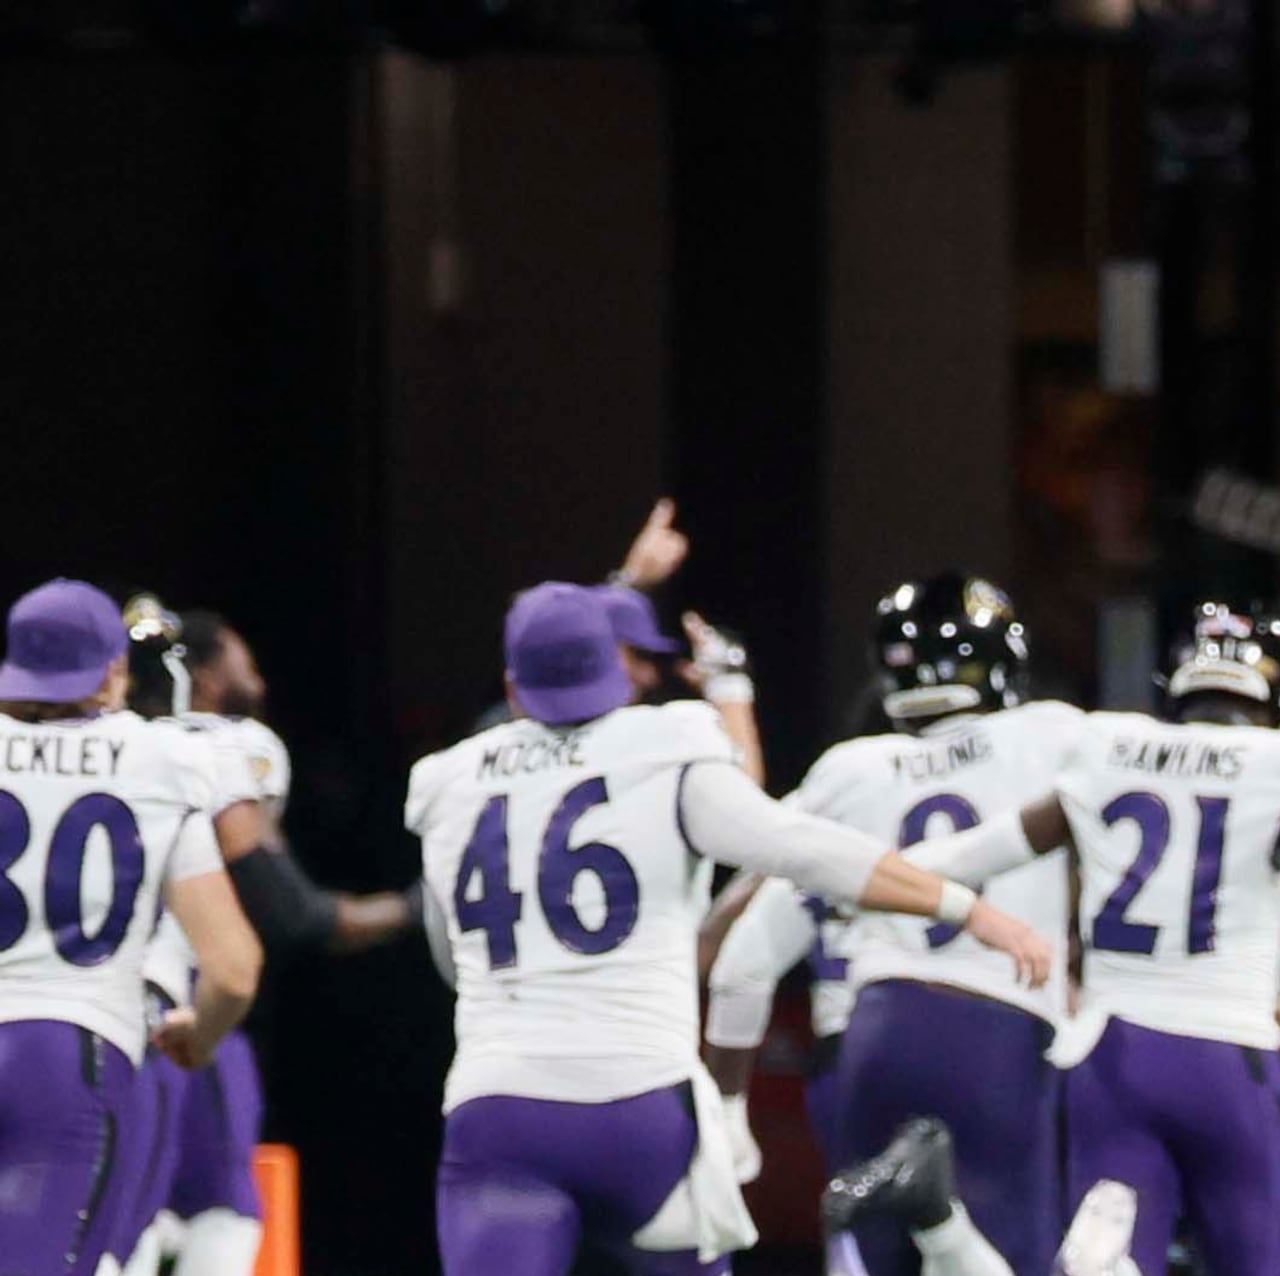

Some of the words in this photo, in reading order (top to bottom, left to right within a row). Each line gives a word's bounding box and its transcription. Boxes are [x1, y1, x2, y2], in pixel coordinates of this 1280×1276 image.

[0, 734, 125, 776] CKLEY
[454, 776, 640, 970] 46
[1093, 791, 1230, 955] 21
